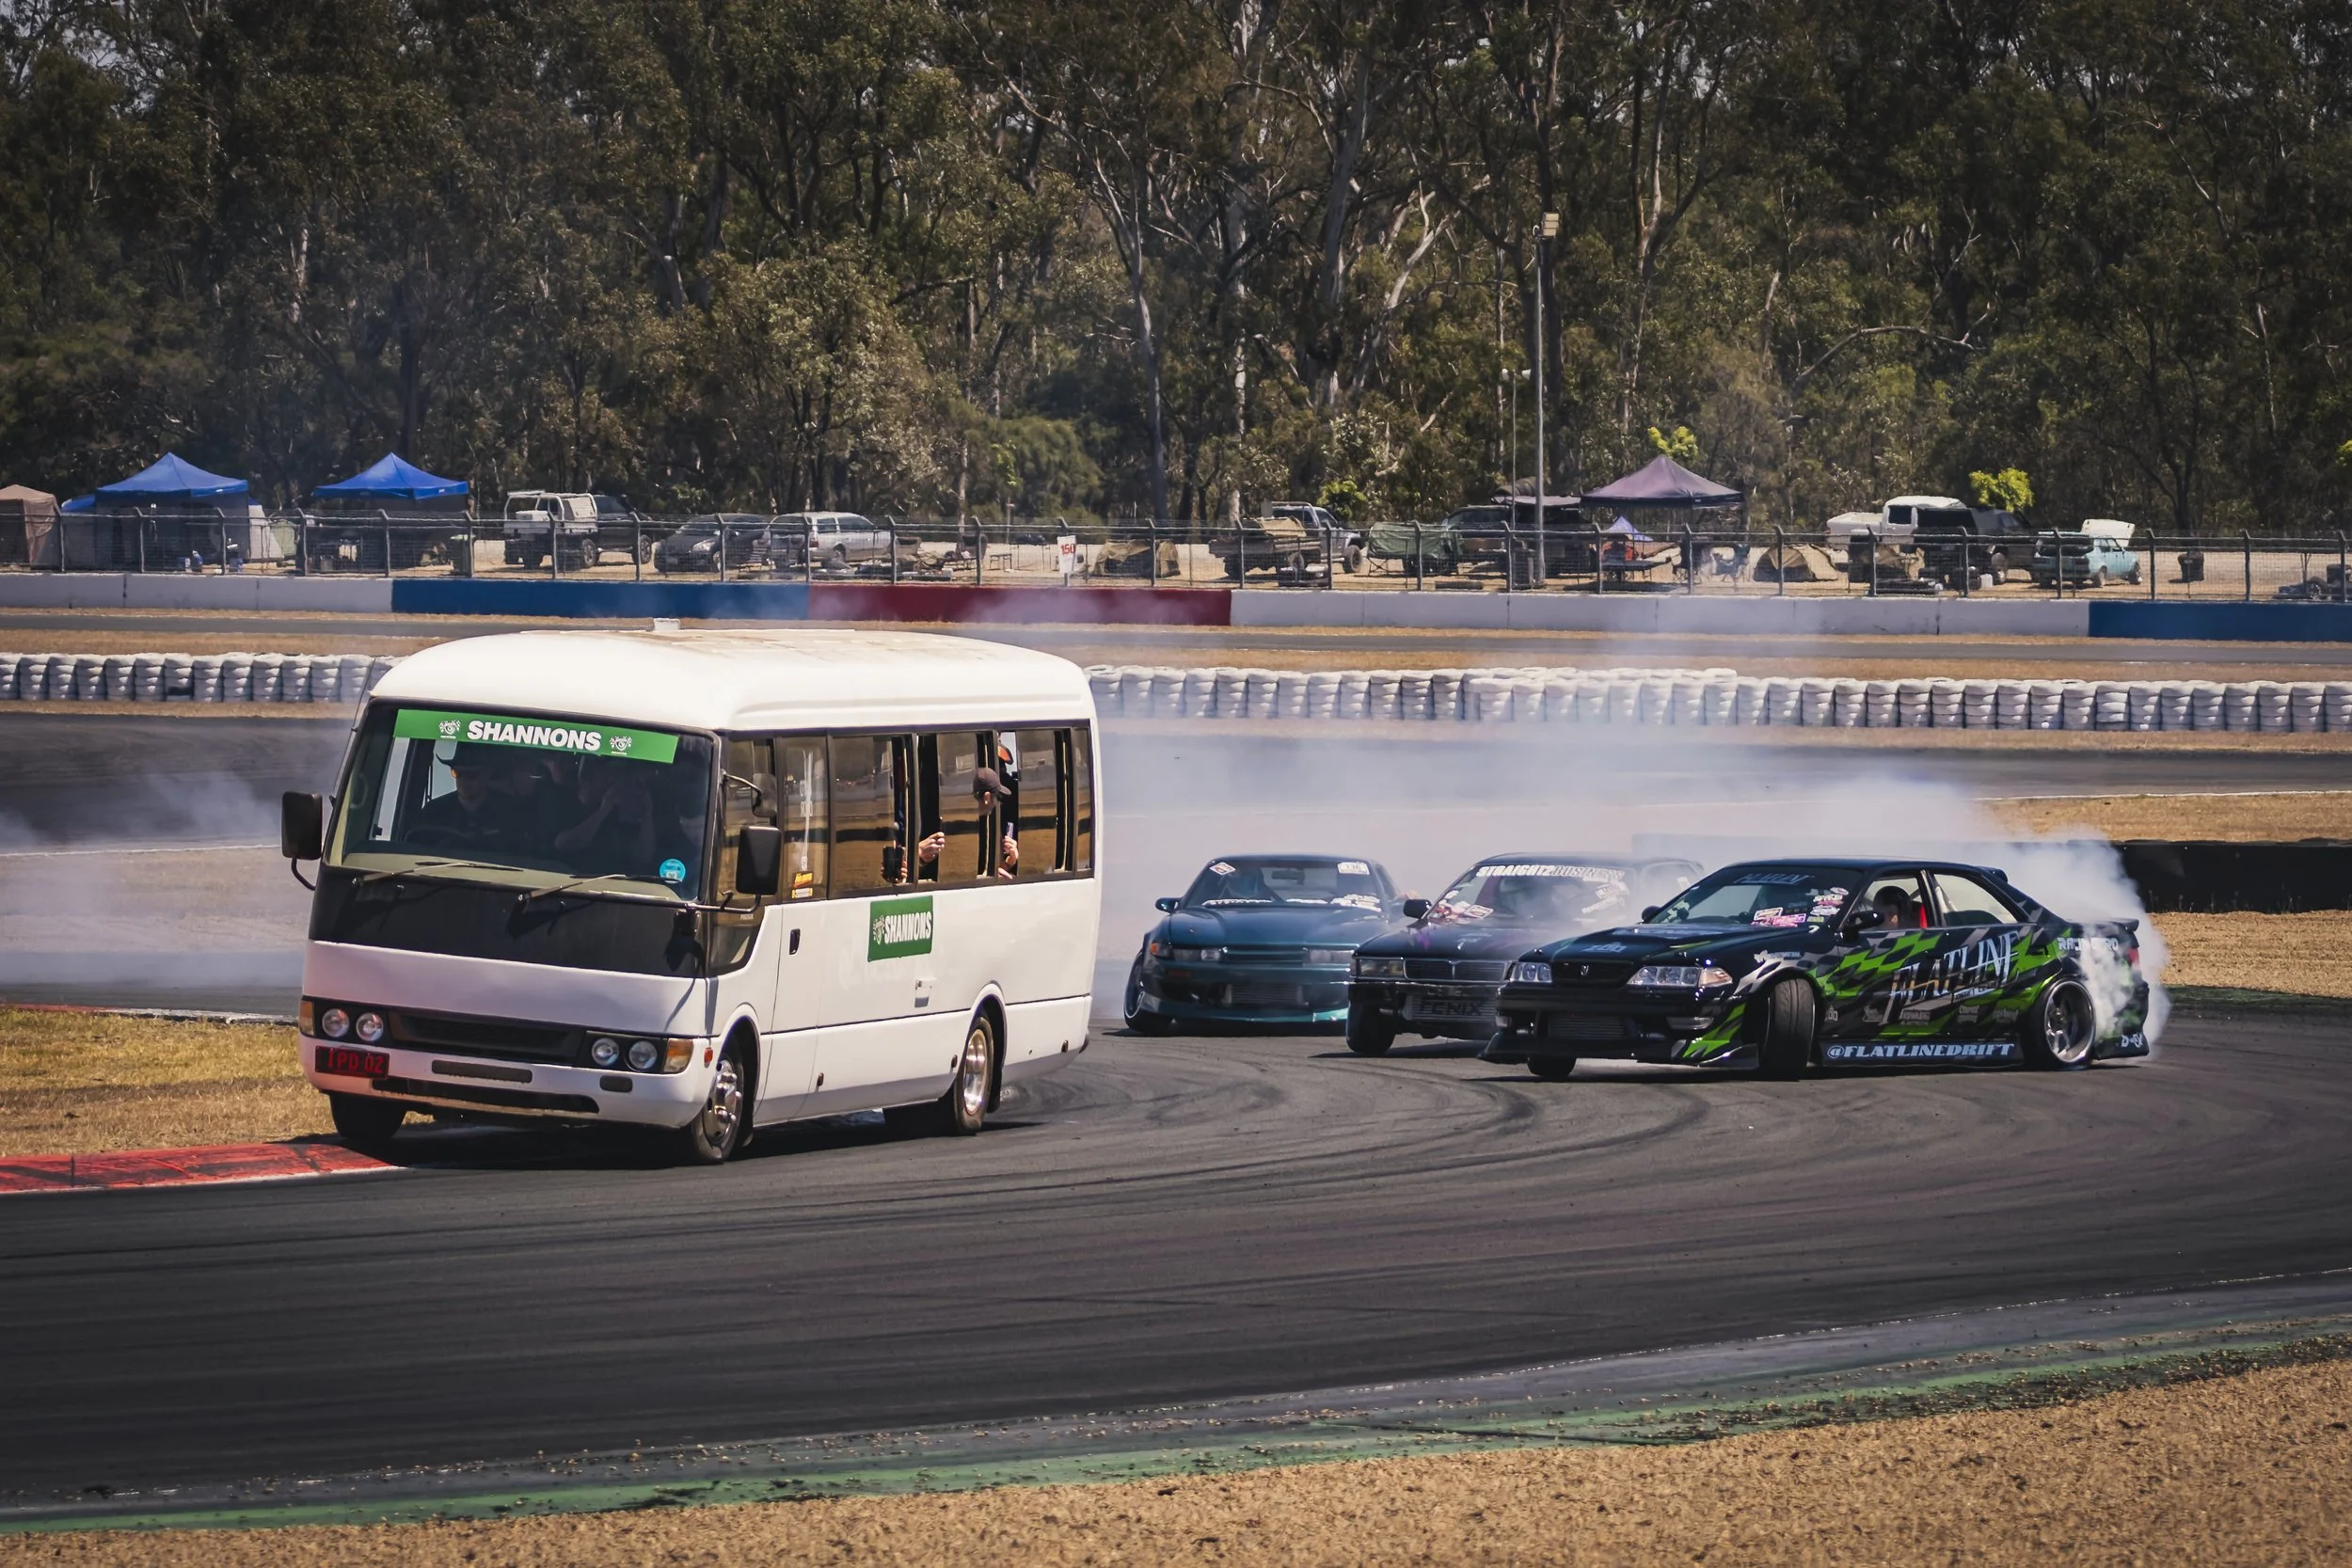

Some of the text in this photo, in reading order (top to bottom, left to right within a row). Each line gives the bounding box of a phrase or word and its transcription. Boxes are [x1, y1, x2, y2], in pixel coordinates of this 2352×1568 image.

[1060, 543, 1076, 555] 150
[467, 720, 602, 752] SHANNONS
[884, 911, 932, 944] SHANNONS
[1880, 930, 2021, 1025] FLATLINE
[1826, 1043, 2014, 1059] @FLATLINEDRIFT
